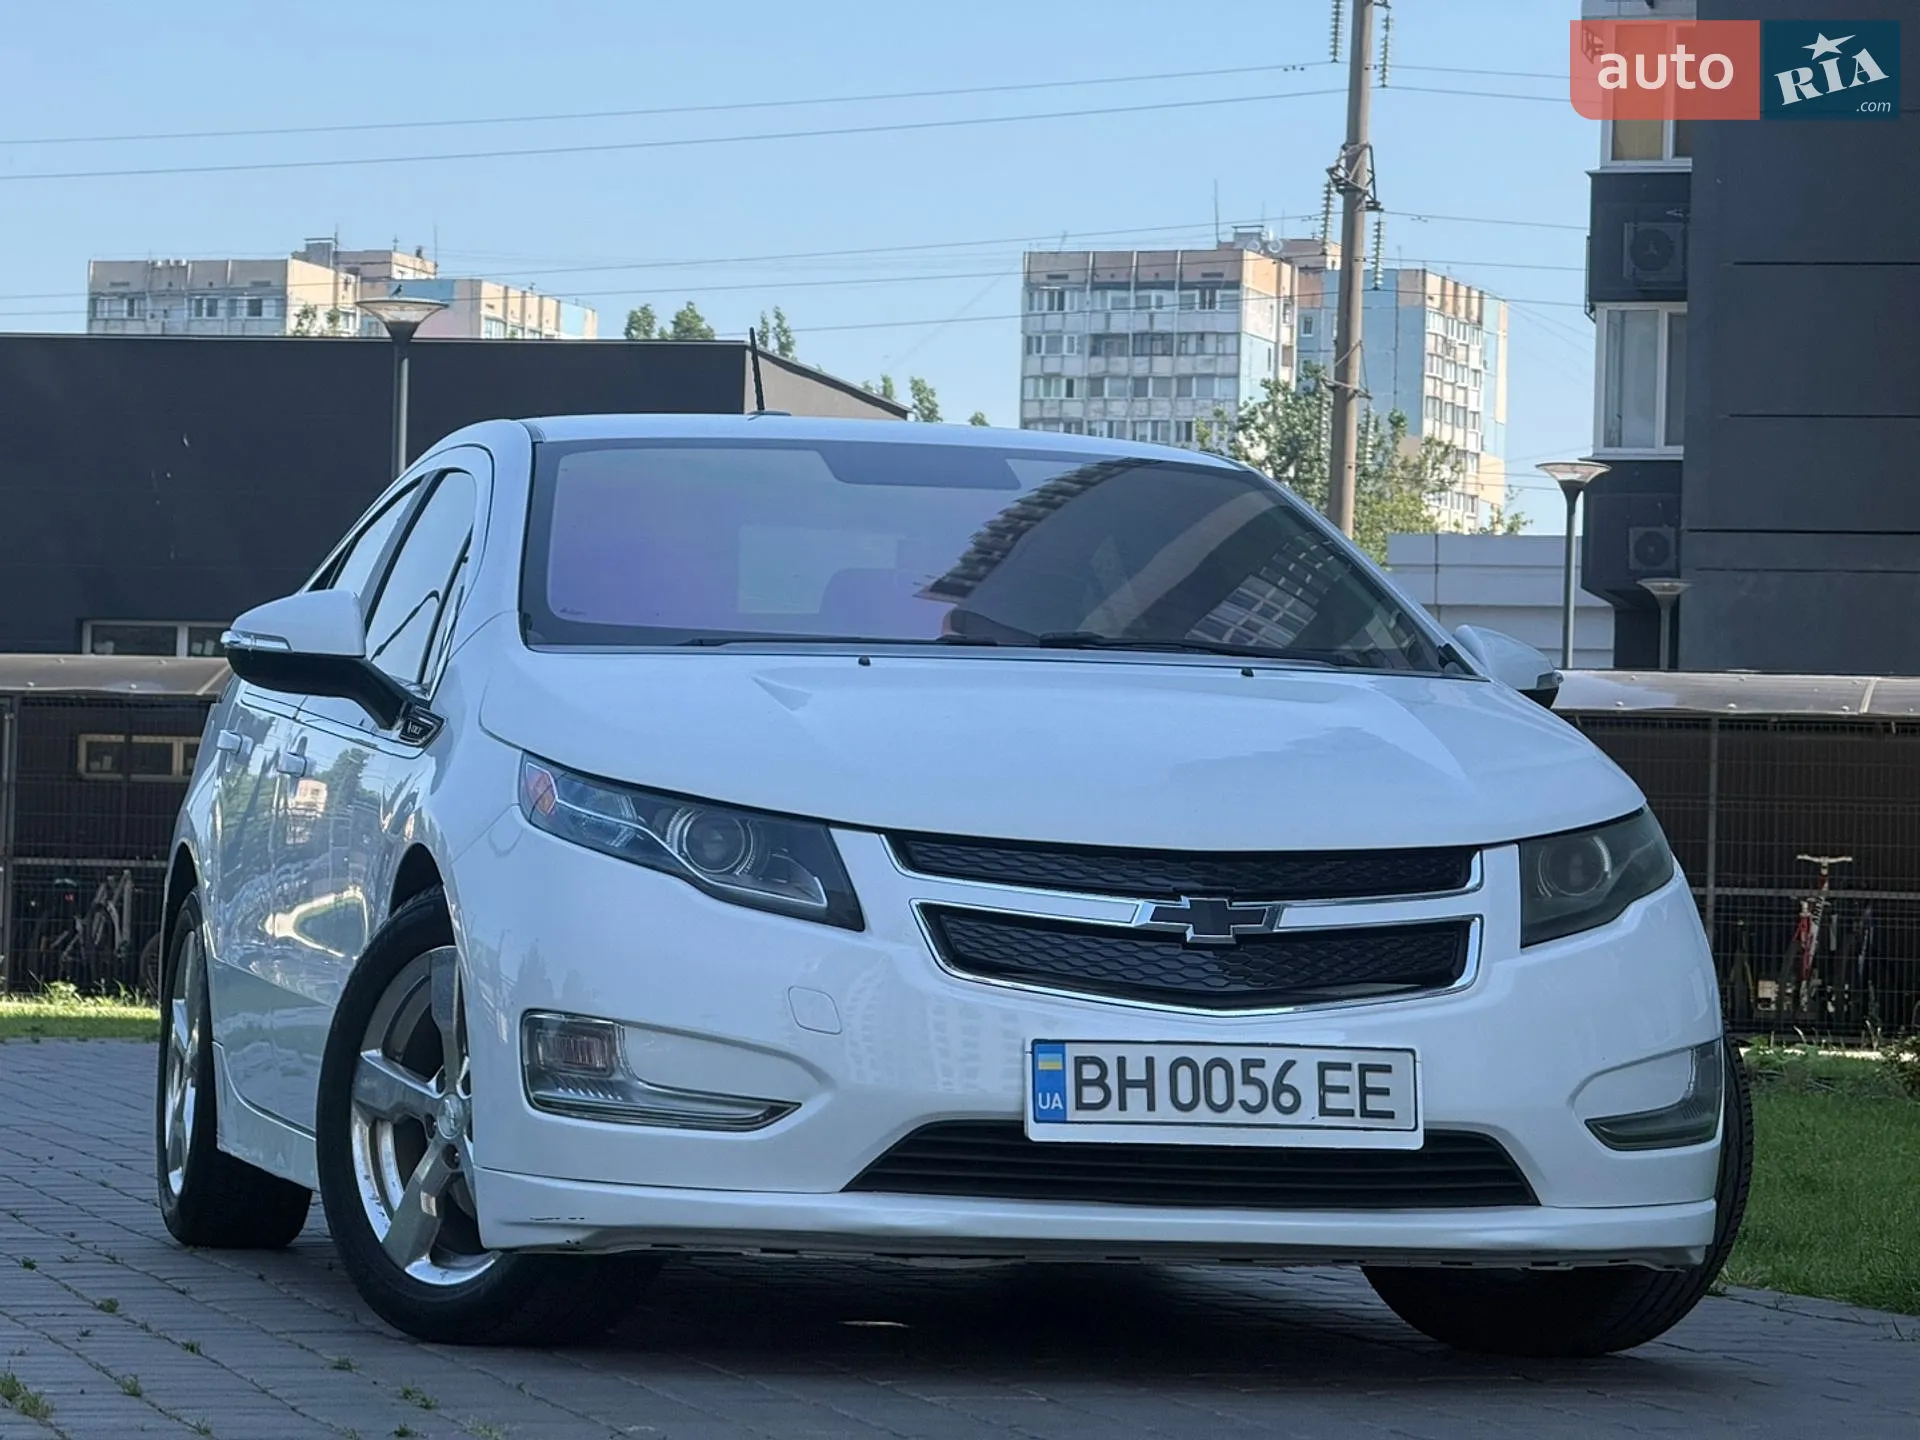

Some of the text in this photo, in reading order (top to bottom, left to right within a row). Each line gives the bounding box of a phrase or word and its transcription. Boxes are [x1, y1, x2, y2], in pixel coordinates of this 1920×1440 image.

[1038, 1091, 1063, 1110] UA
[1073, 1055, 1396, 1119] BH 0056 EE
